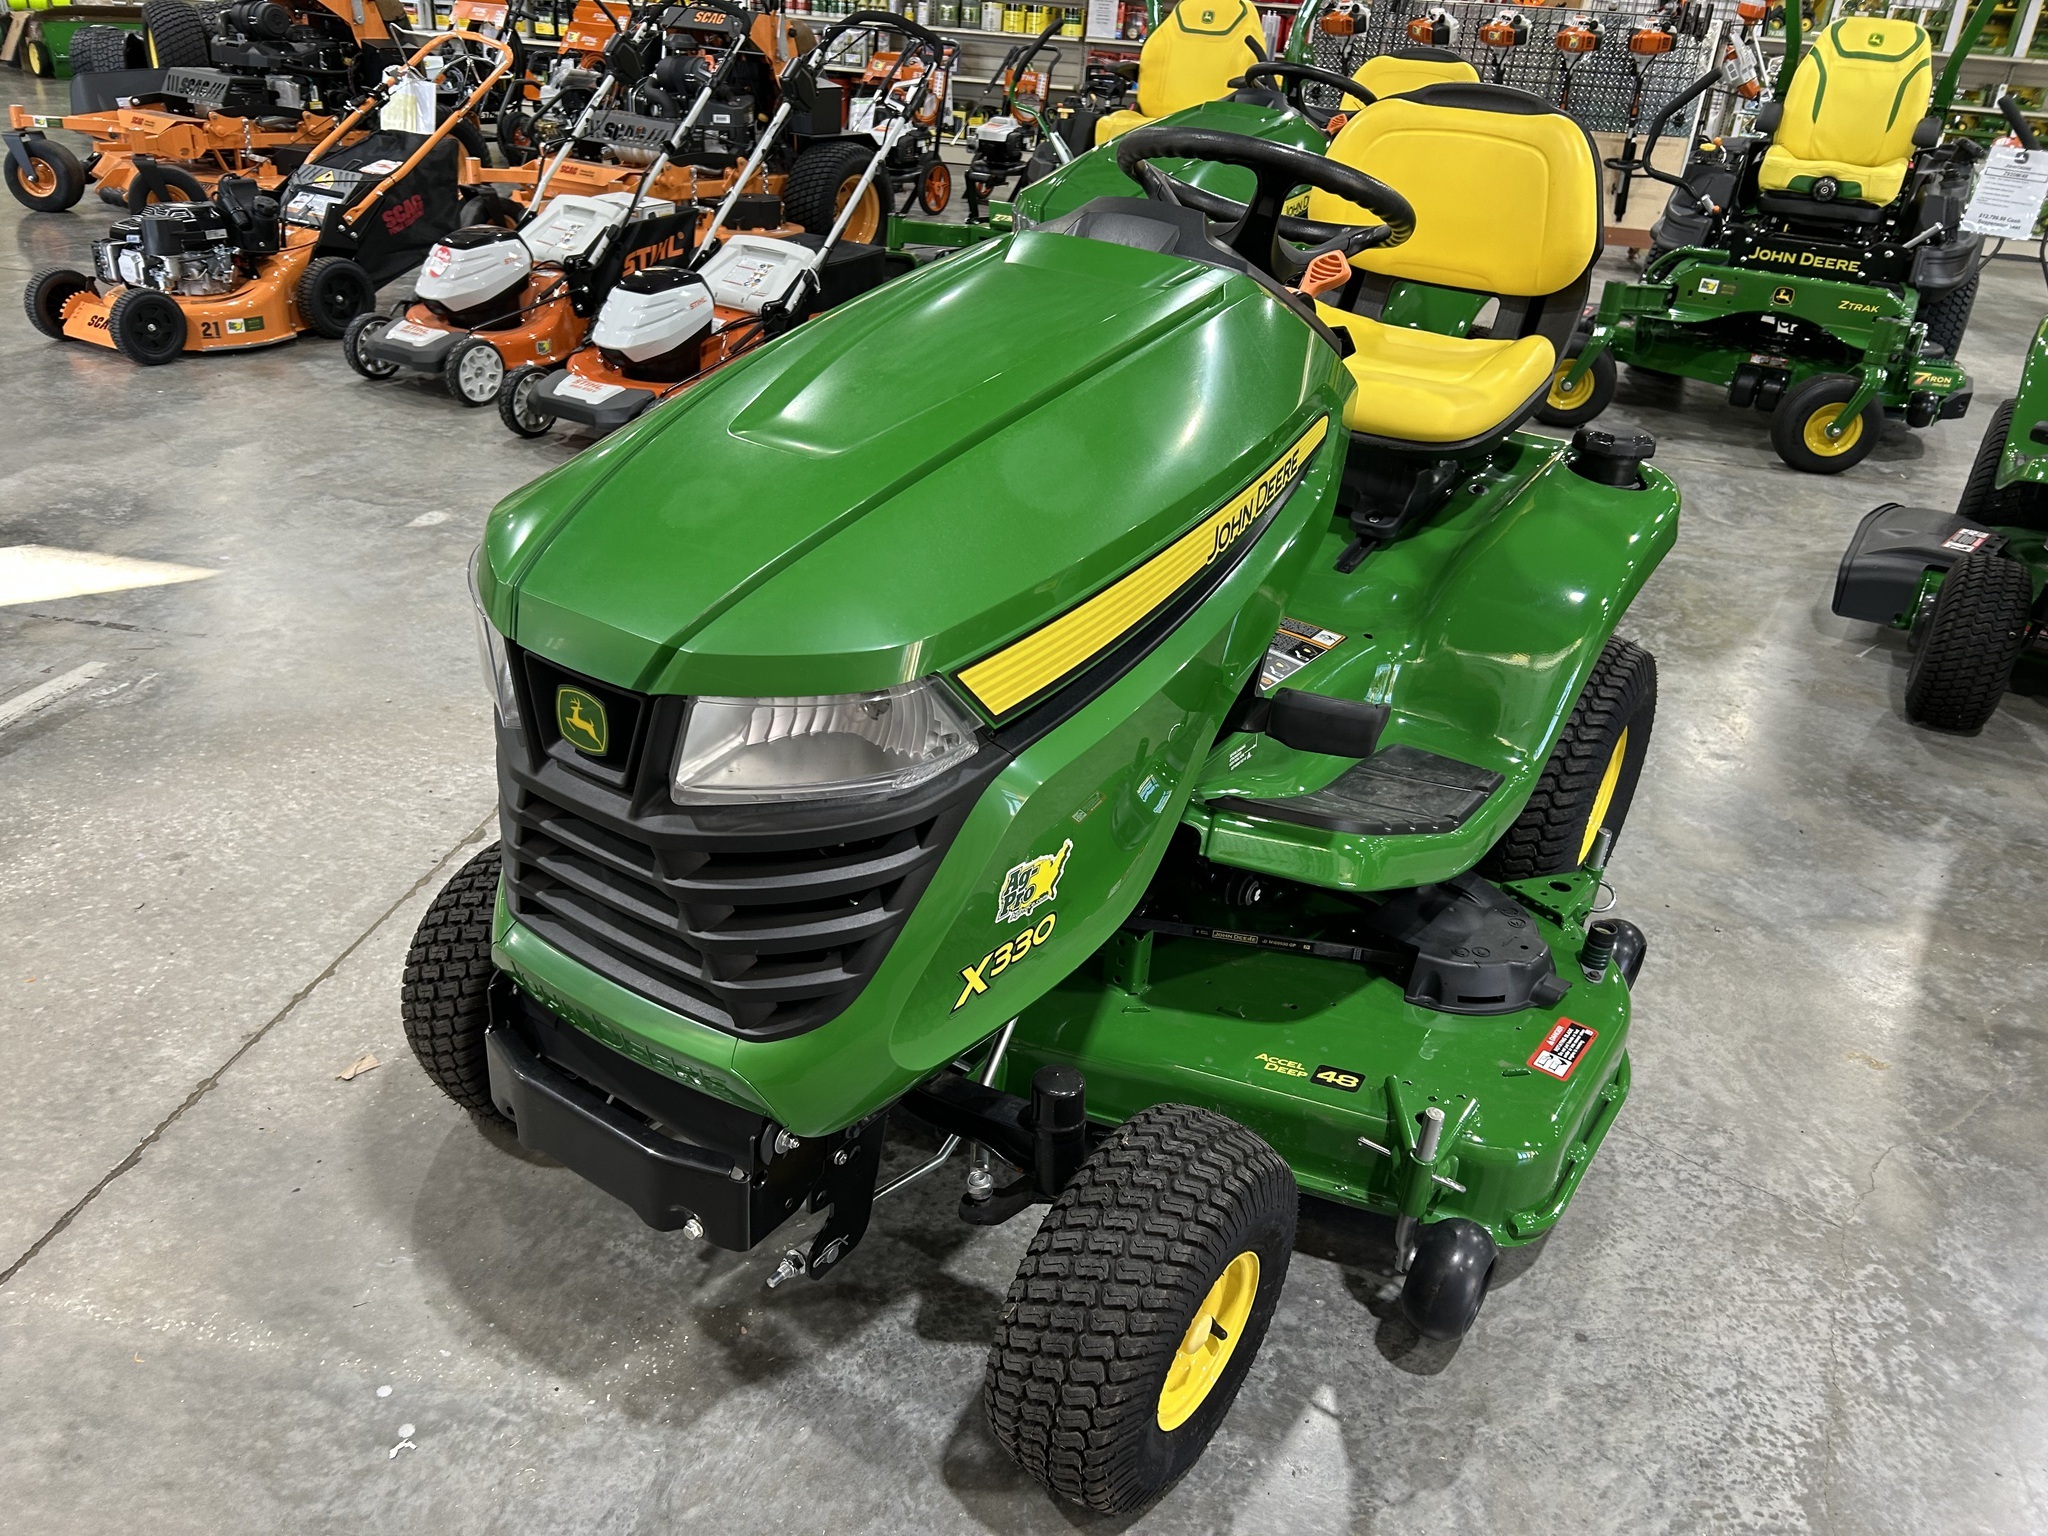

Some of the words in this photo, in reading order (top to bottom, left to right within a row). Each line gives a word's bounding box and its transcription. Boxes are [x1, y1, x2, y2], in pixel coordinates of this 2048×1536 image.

[694, 11, 727, 24] SCAG
[179, 77, 210, 97] SCAG
[603, 122, 647, 140] SCAG
[560, 165, 579, 175] SCAG
[382, 194, 424, 228] SCAG
[622, 235, 684, 277] STIHL
[1748, 246, 1797, 264] JOHN
[1799, 252, 1861, 272] DEERE
[1838, 300, 1879, 313] ZTRAK
[88, 315, 109, 331] SCA
[201, 321, 221, 338] 21
[1206, 498, 1255, 564] JOHN
[1255, 448, 1300, 517] DEERE
[1004, 865, 1041, 897] Ag-
[1000, 884, 1039, 917] Pro
[950, 911, 1058, 1014] X330
[1254, 1053, 1306, 1071] ACCEL
[1263, 1062, 1309, 1078] DEEP
[1316, 1070, 1360, 1088] 48
